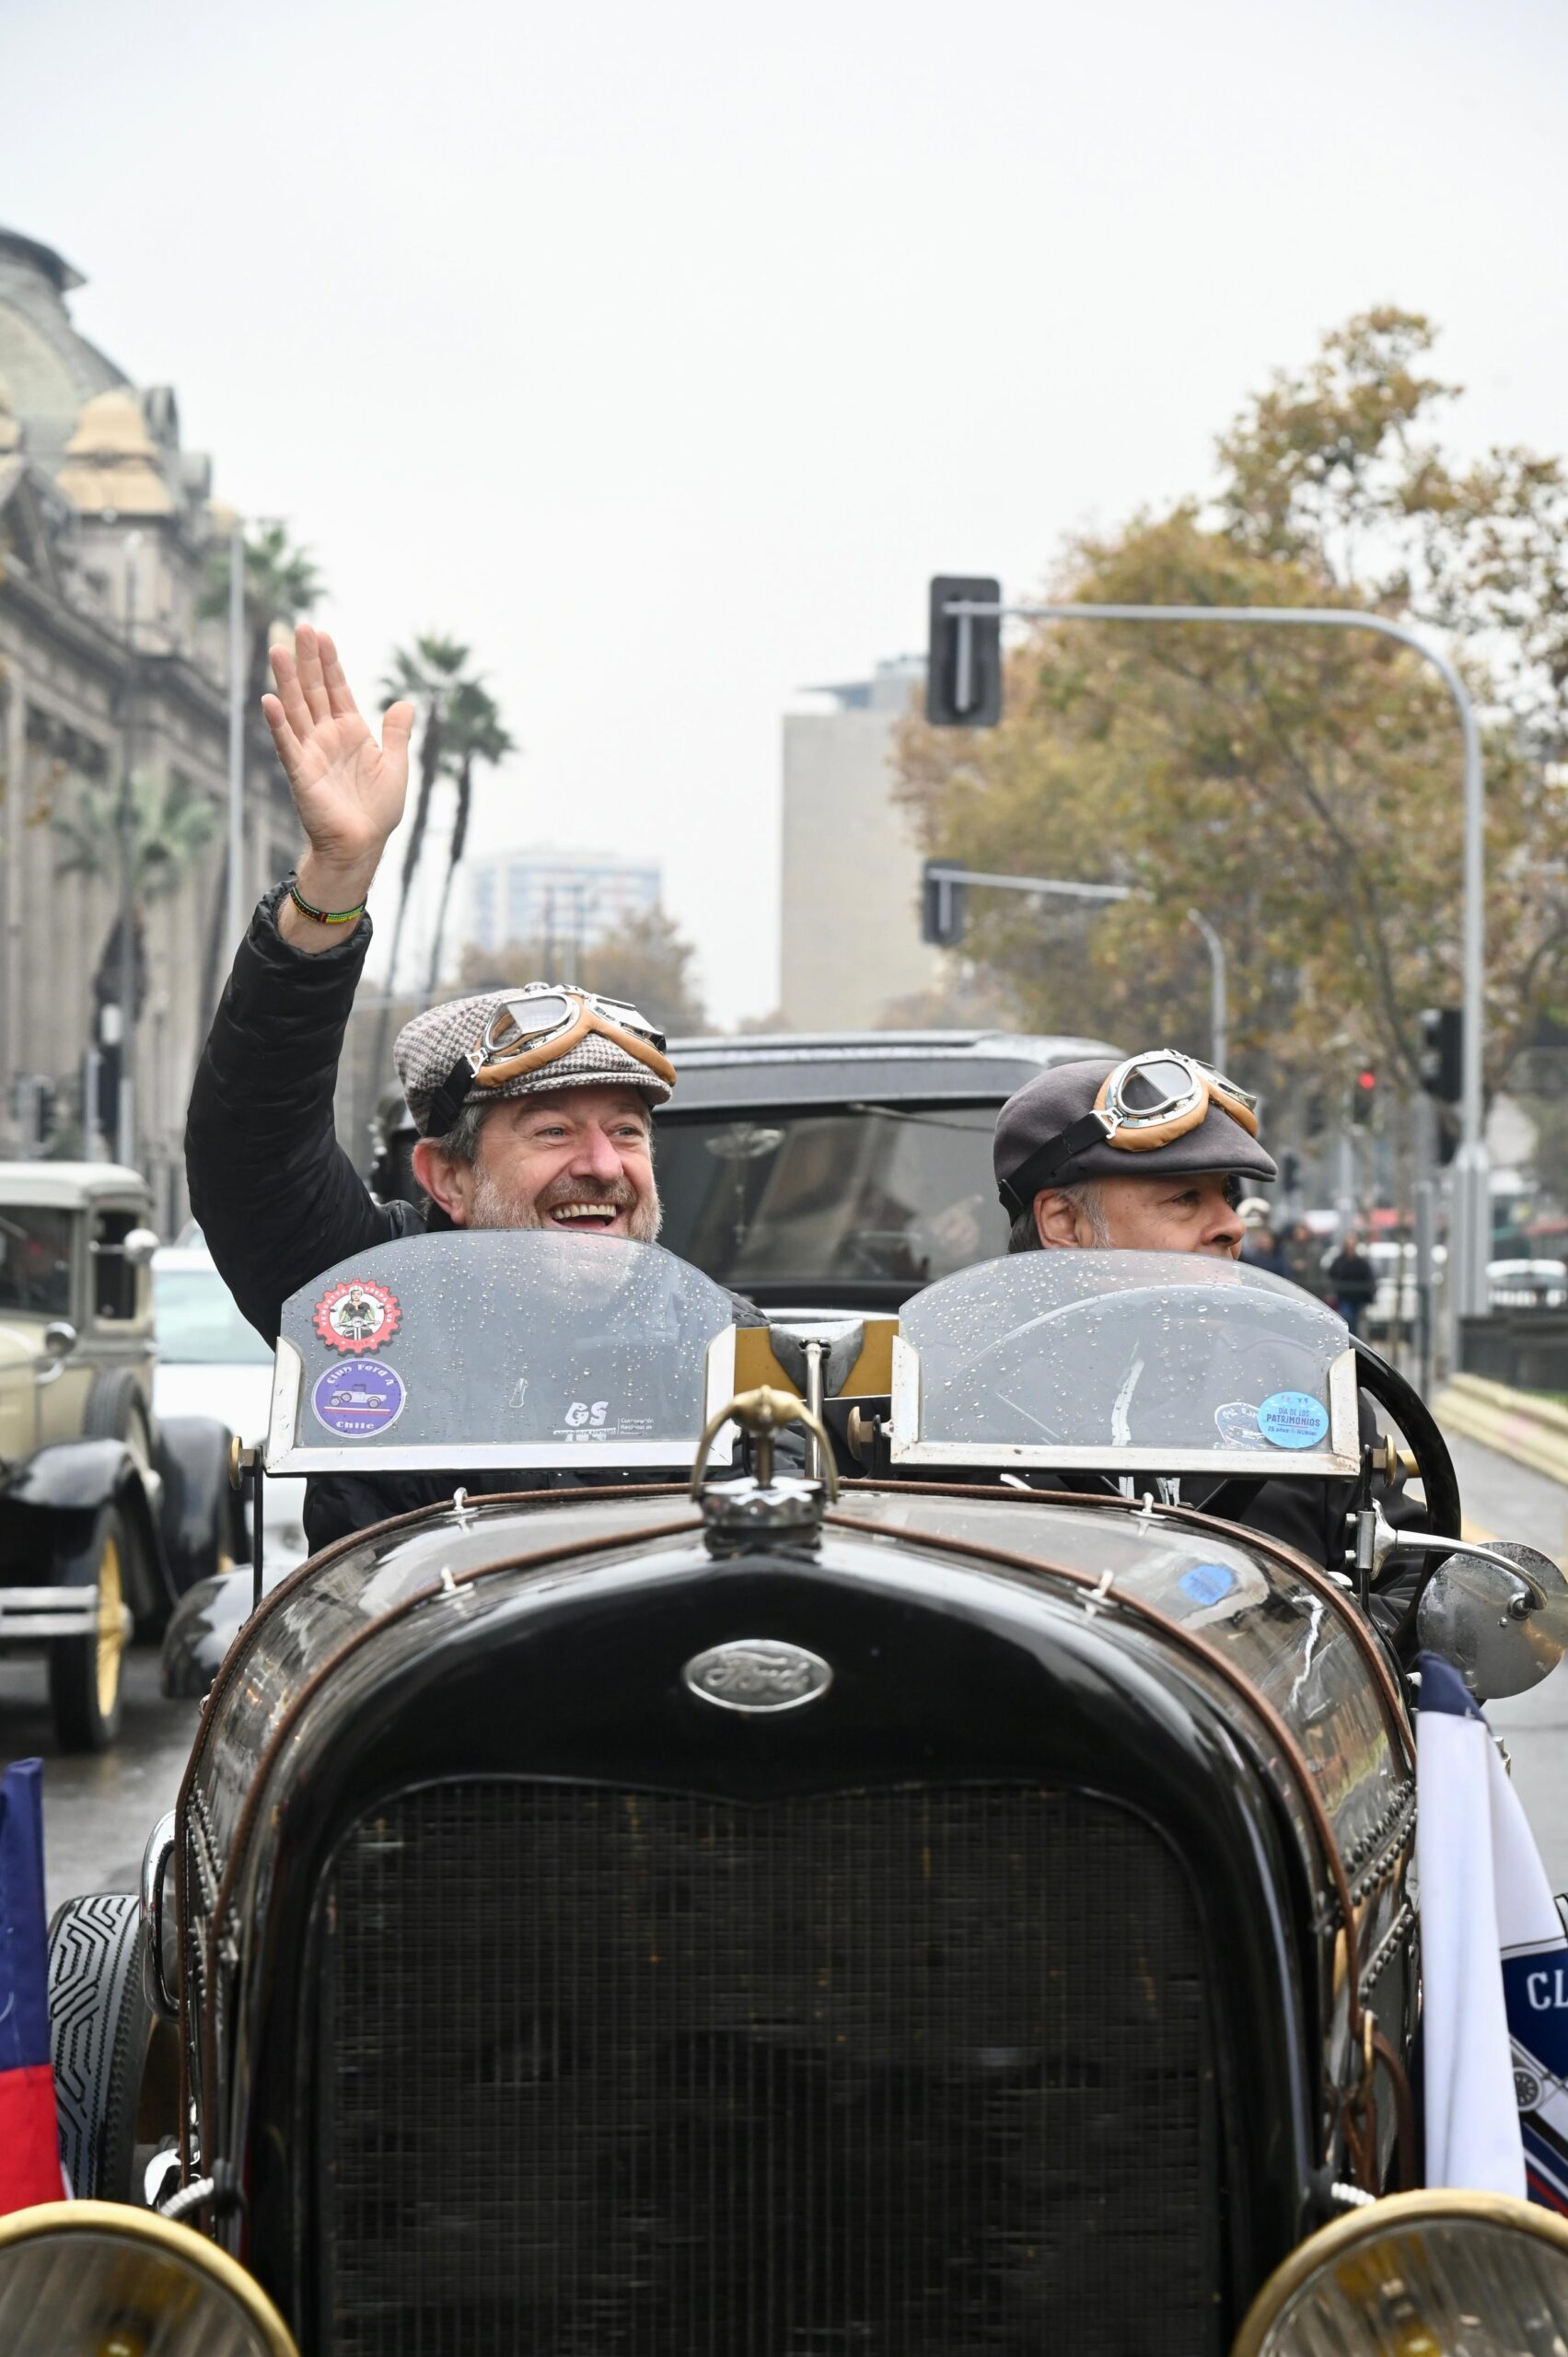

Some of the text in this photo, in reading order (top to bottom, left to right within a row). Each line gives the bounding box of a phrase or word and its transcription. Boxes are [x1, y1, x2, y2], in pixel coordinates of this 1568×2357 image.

[365, 1286, 388, 1303] VESPA
[385, 1304, 394, 1323] CLUB
[326, 1366, 353, 1384] Club
[357, 1364, 388, 1376] Ford
[563, 1400, 609, 1427] GS
[1266, 1413, 1320, 1427] PATRIMONIOS
[1278, 1406, 1310, 1417] DÍA DE LOS
[335, 1421, 375, 1430] Chile
[1526, 1968, 1568, 2011] CL
